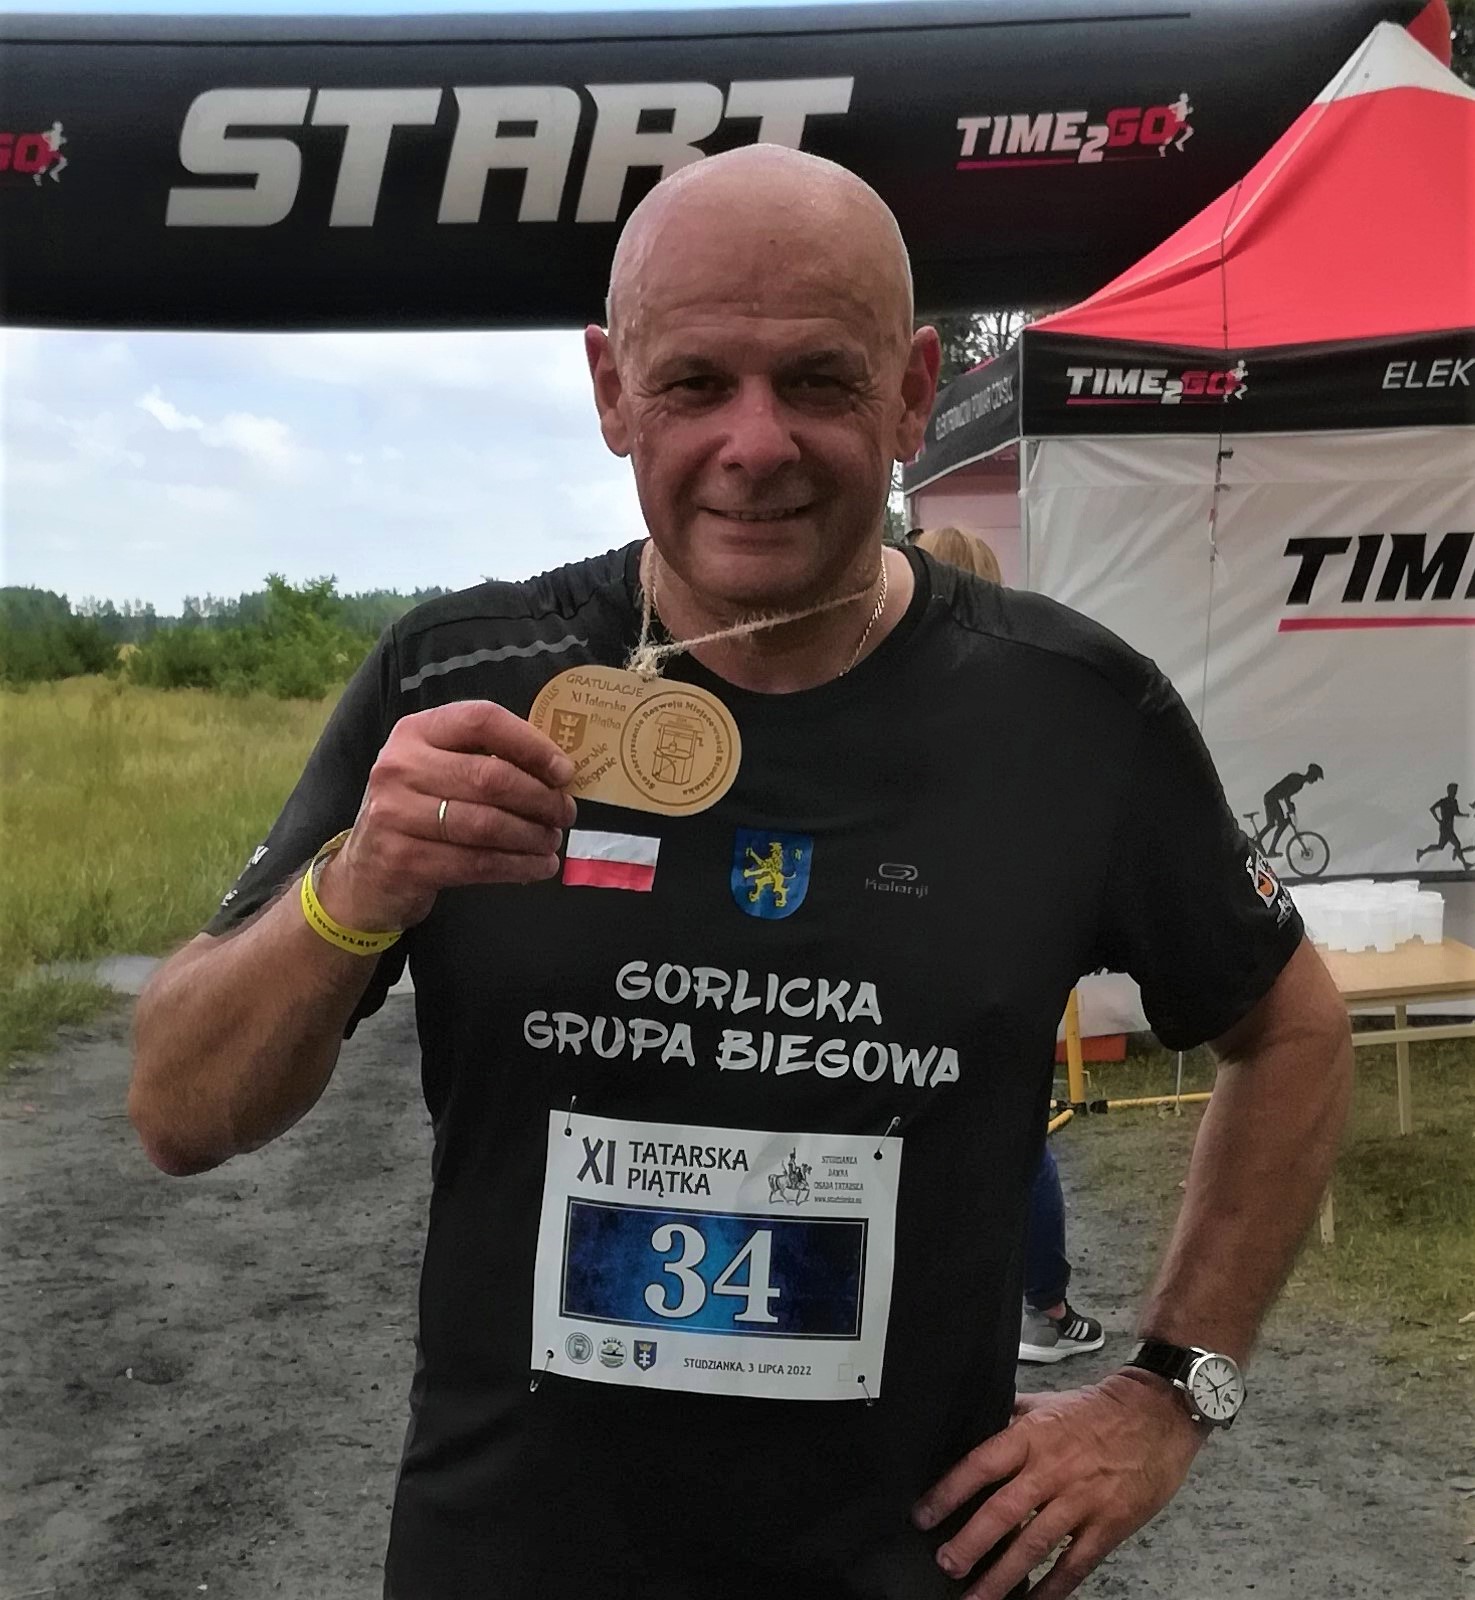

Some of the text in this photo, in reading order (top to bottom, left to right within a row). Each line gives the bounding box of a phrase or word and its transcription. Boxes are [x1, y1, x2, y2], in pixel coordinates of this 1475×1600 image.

[165, 76, 854, 227] START
[956, 106, 1181, 164] TIME2GO
[1065, 367, 1238, 405] TIME2GO
[1381, 357, 1475, 390] ELEK
[1283, 531, 1475, 606] TIM
[566, 673, 645, 698] GRATULACJE
[614, 959, 883, 1026] GORLICKA
[523, 1010, 961, 1089] GRUPA BIEGOWA
[576, 1135, 750, 1187] XI TATARSKA
[626, 1167, 712, 1198] PIĄTKA
[644, 1223, 781, 1324] 34
[748, 1362, 755, 1373] 3
[758, 1363, 785, 1375] LIPCA
[786, 1365, 812, 1376] 2022
